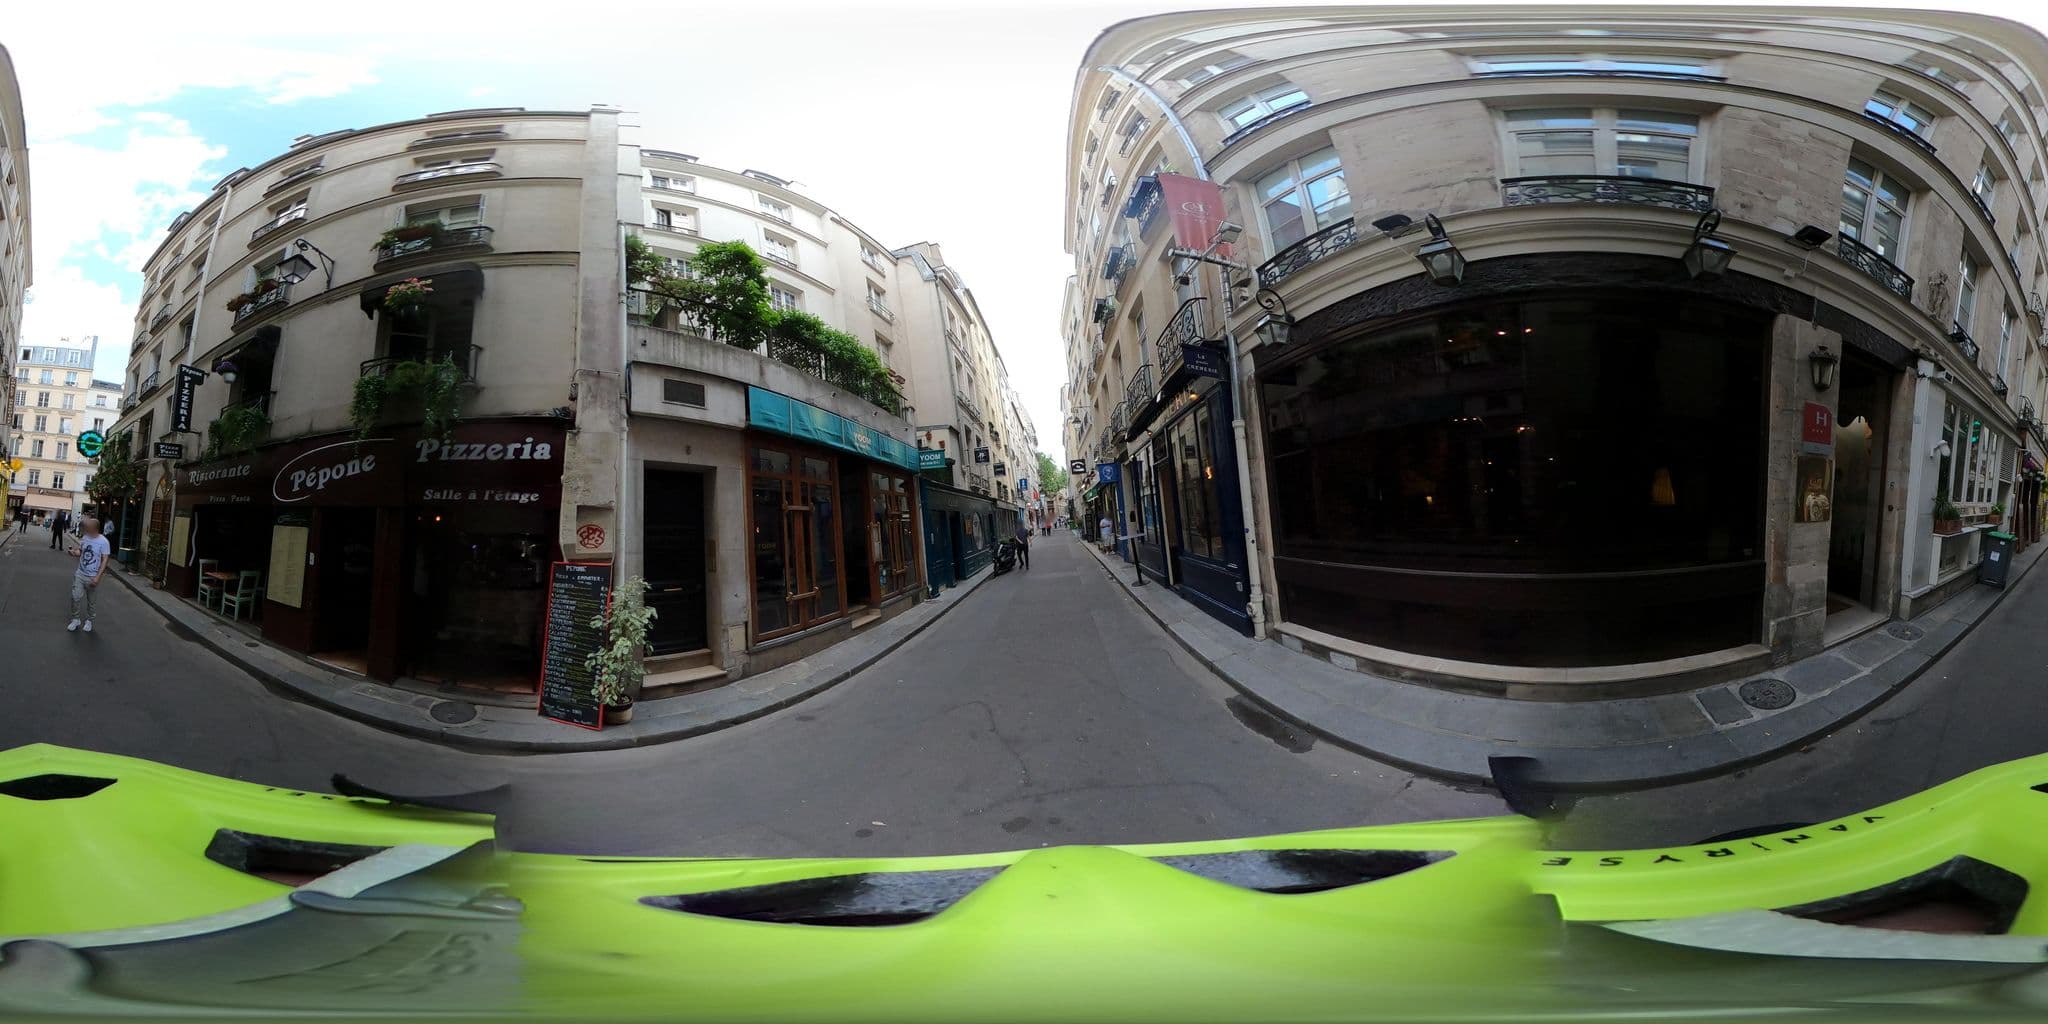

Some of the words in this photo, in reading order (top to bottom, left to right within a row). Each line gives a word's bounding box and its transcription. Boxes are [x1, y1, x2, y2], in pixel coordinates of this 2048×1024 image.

[177, 375, 191, 430] PIZZERIA
[1816, 411, 1828, 427] H
[416, 436, 552, 463] Pizzeria
[919, 453, 941, 461] YOOM
[188, 464, 251, 487] Ristorante
[290, 453, 376, 492] Pépone
[423, 488, 462, 501] Salle
[467, 488, 477, 501] à
[484, 488, 540, 504] l'étage
